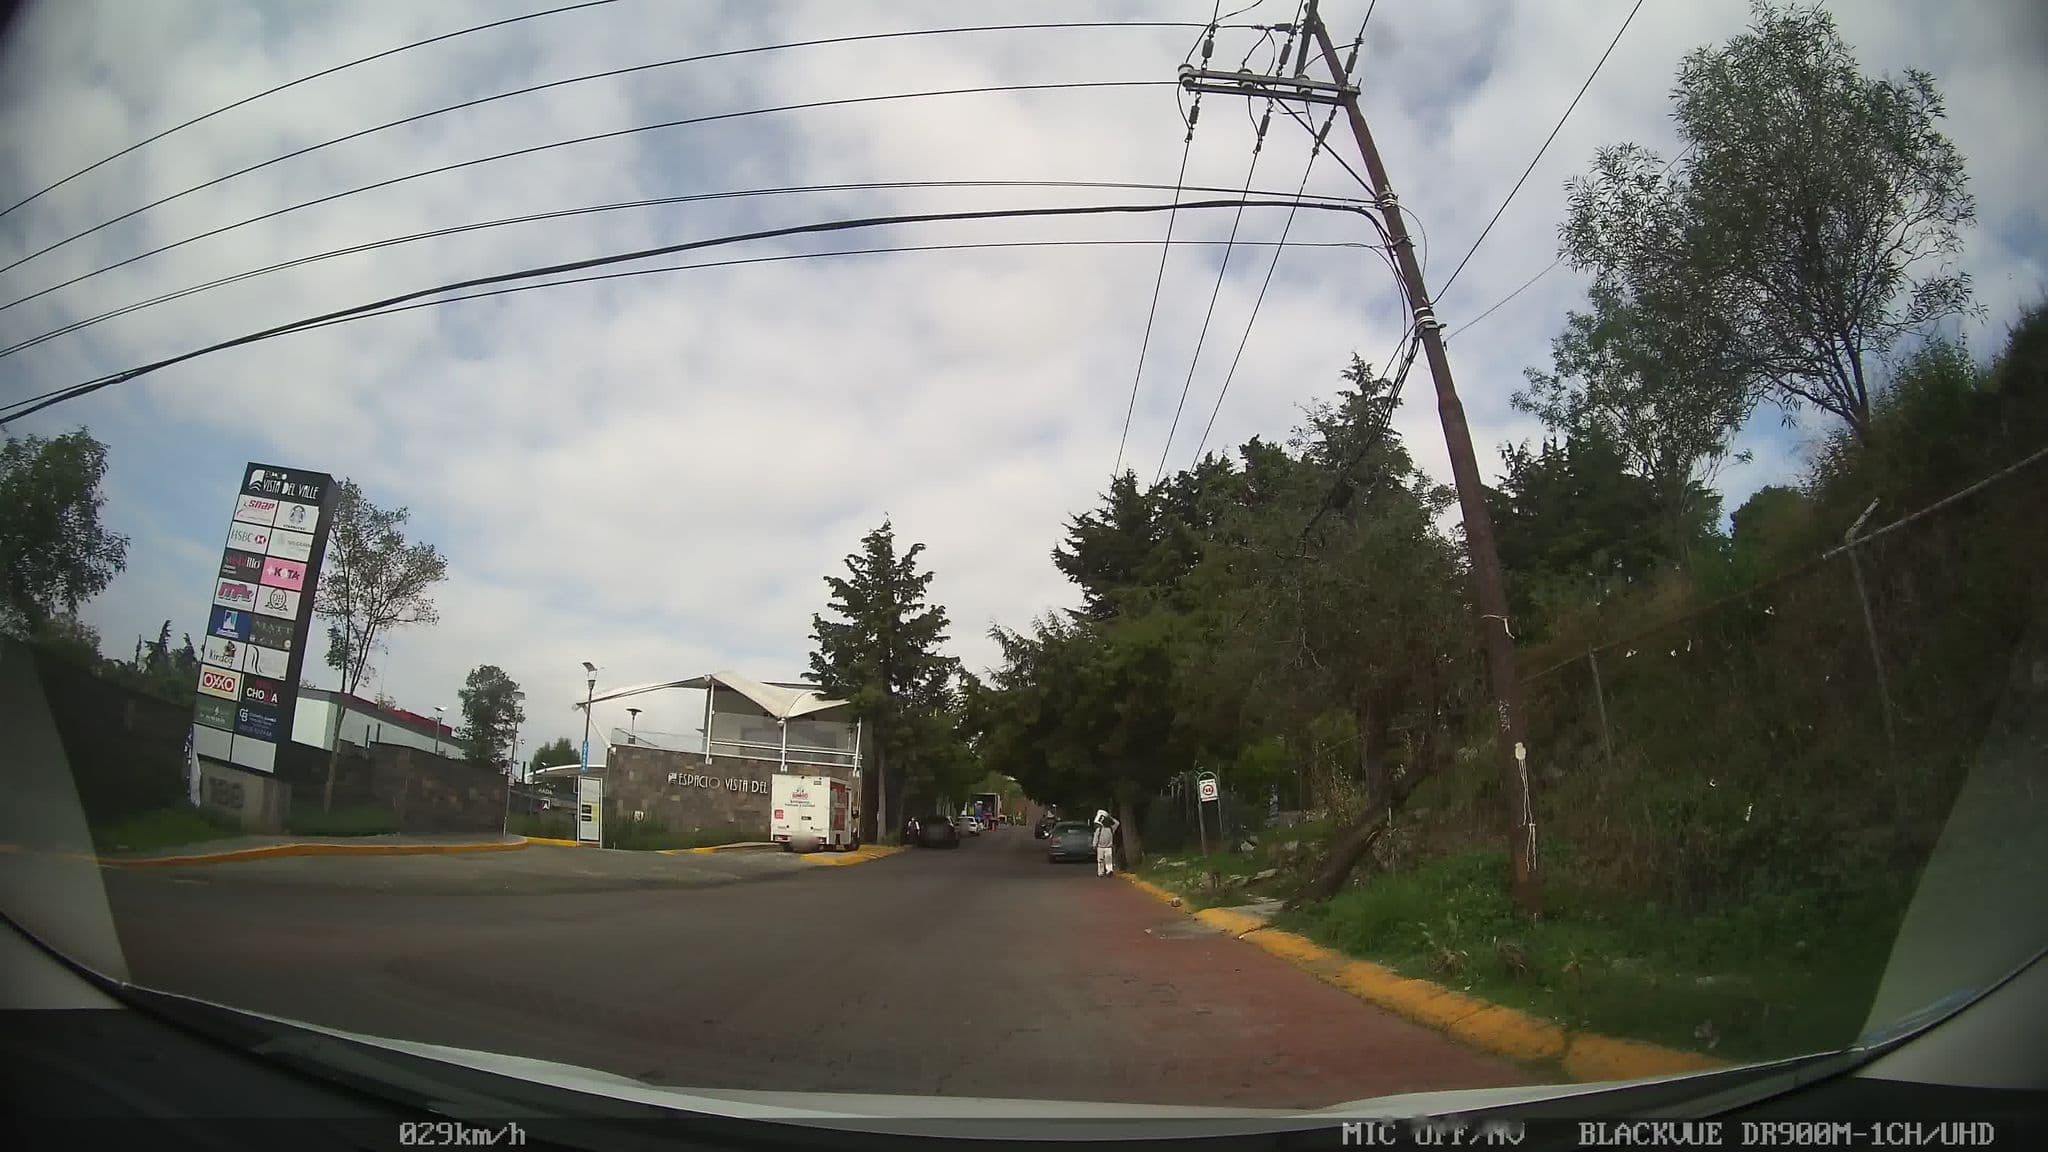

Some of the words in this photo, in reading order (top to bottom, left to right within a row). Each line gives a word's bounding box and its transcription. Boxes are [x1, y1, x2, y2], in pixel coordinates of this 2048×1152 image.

[263, 479, 280, 494] VISTA
[281, 482, 296, 497] DEL
[299, 484, 319, 500] VALLE
[231, 528, 253, 543] HSBC
[203, 672, 235, 692] OXXO
[678, 773, 721, 789] ESPACIO
[725, 778, 748, 792] VISTA
[751, 781, 768, 794] DEL
